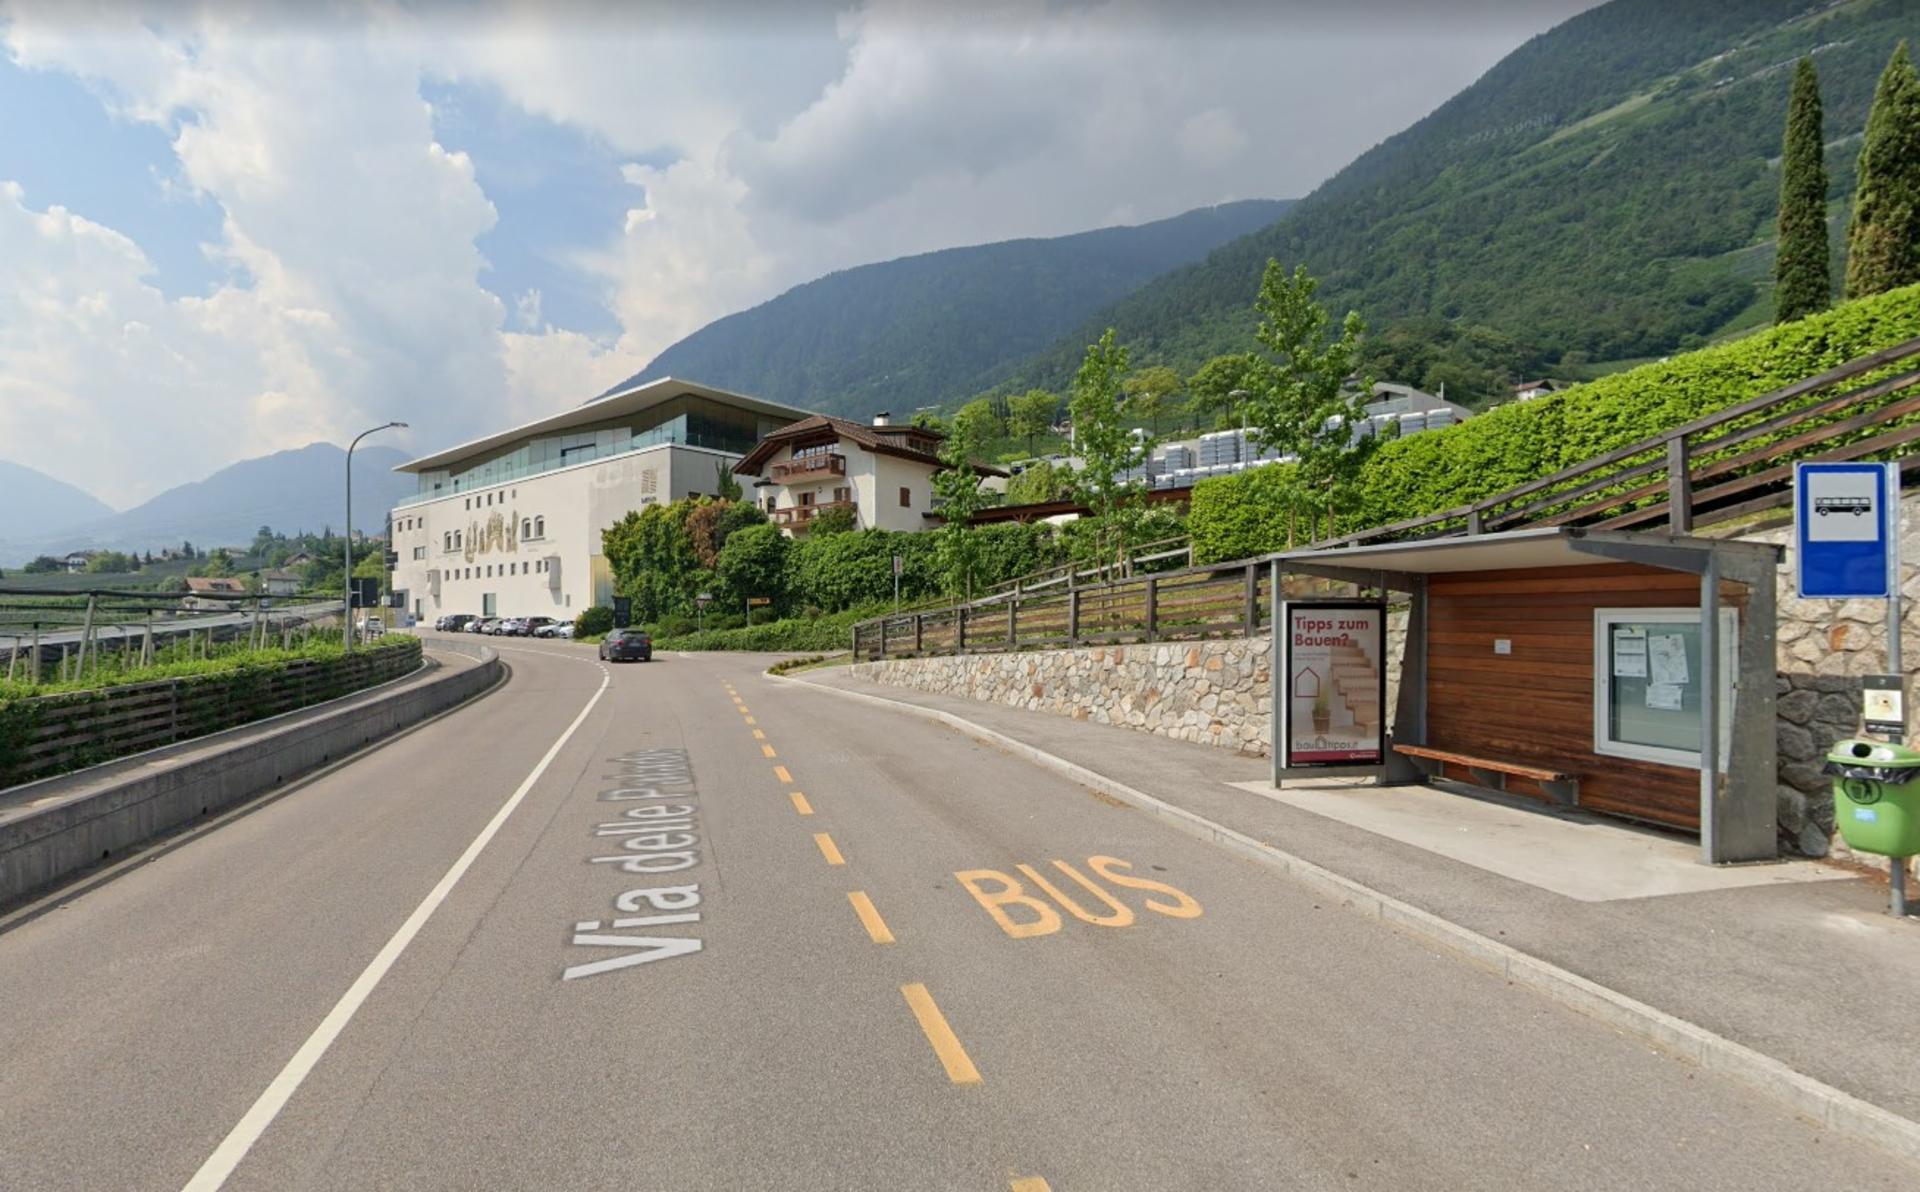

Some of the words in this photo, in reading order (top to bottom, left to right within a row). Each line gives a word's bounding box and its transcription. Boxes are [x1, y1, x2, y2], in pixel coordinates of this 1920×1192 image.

[1294, 616, 1332, 633] Tipps
[1338, 619, 1369, 630] zum
[1294, 633, 1349, 647] Bauen?
[954, 855, 1203, 939] BUS
